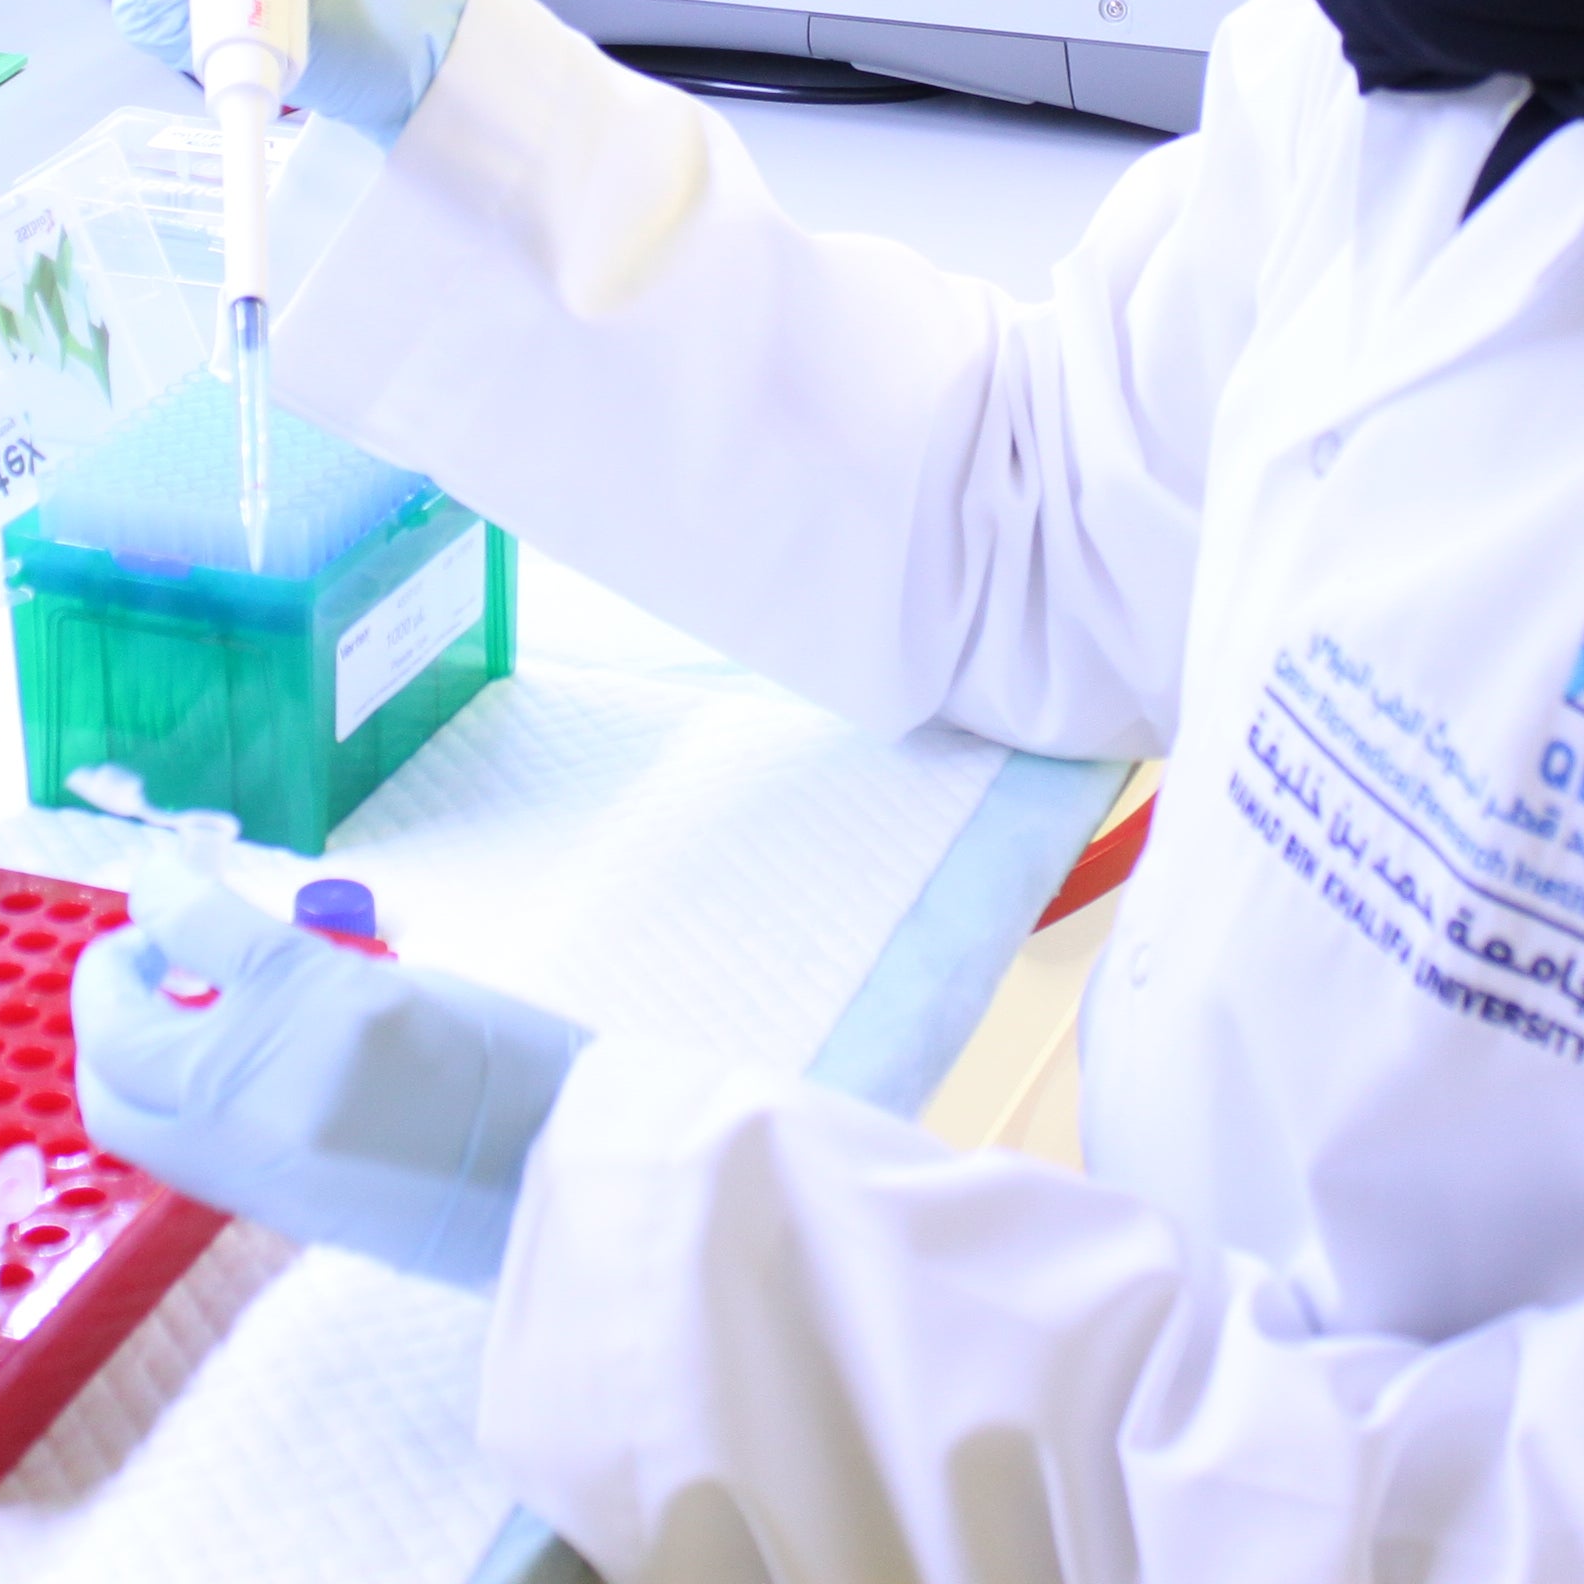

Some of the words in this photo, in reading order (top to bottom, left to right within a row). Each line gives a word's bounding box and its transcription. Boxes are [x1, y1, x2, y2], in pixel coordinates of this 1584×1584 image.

[1248, 709, 1322, 820] خليفة
[1317, 693, 1419, 808] Biomedical
[1416, 782, 1507, 876] Research
[1328, 800, 1367, 868] بن
[1227, 769, 1283, 846] HAMAD
[1283, 832, 1319, 887] BIN
[1322, 871, 1412, 969] KHALIFA
